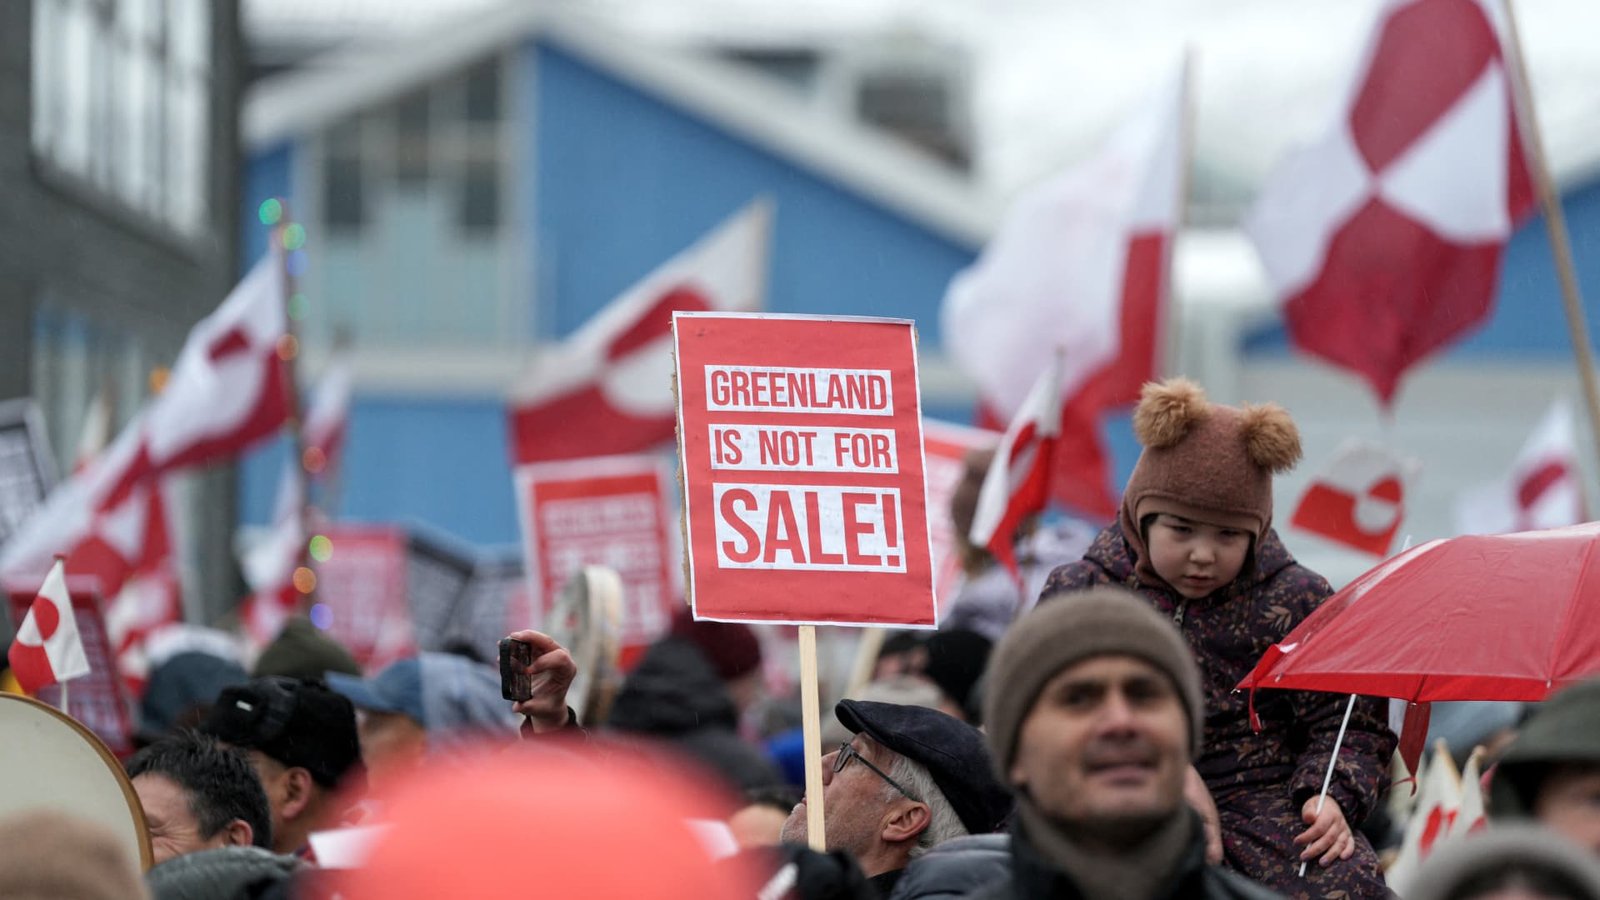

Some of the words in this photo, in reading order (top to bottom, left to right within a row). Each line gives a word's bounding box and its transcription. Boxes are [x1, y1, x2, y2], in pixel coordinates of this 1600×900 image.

[711, 371, 887, 409] GREENLAND
[714, 430, 742, 464] IS
[759, 431, 816, 466] NOT
[834, 434, 892, 467] FOR
[720, 488, 900, 566] SALE!
